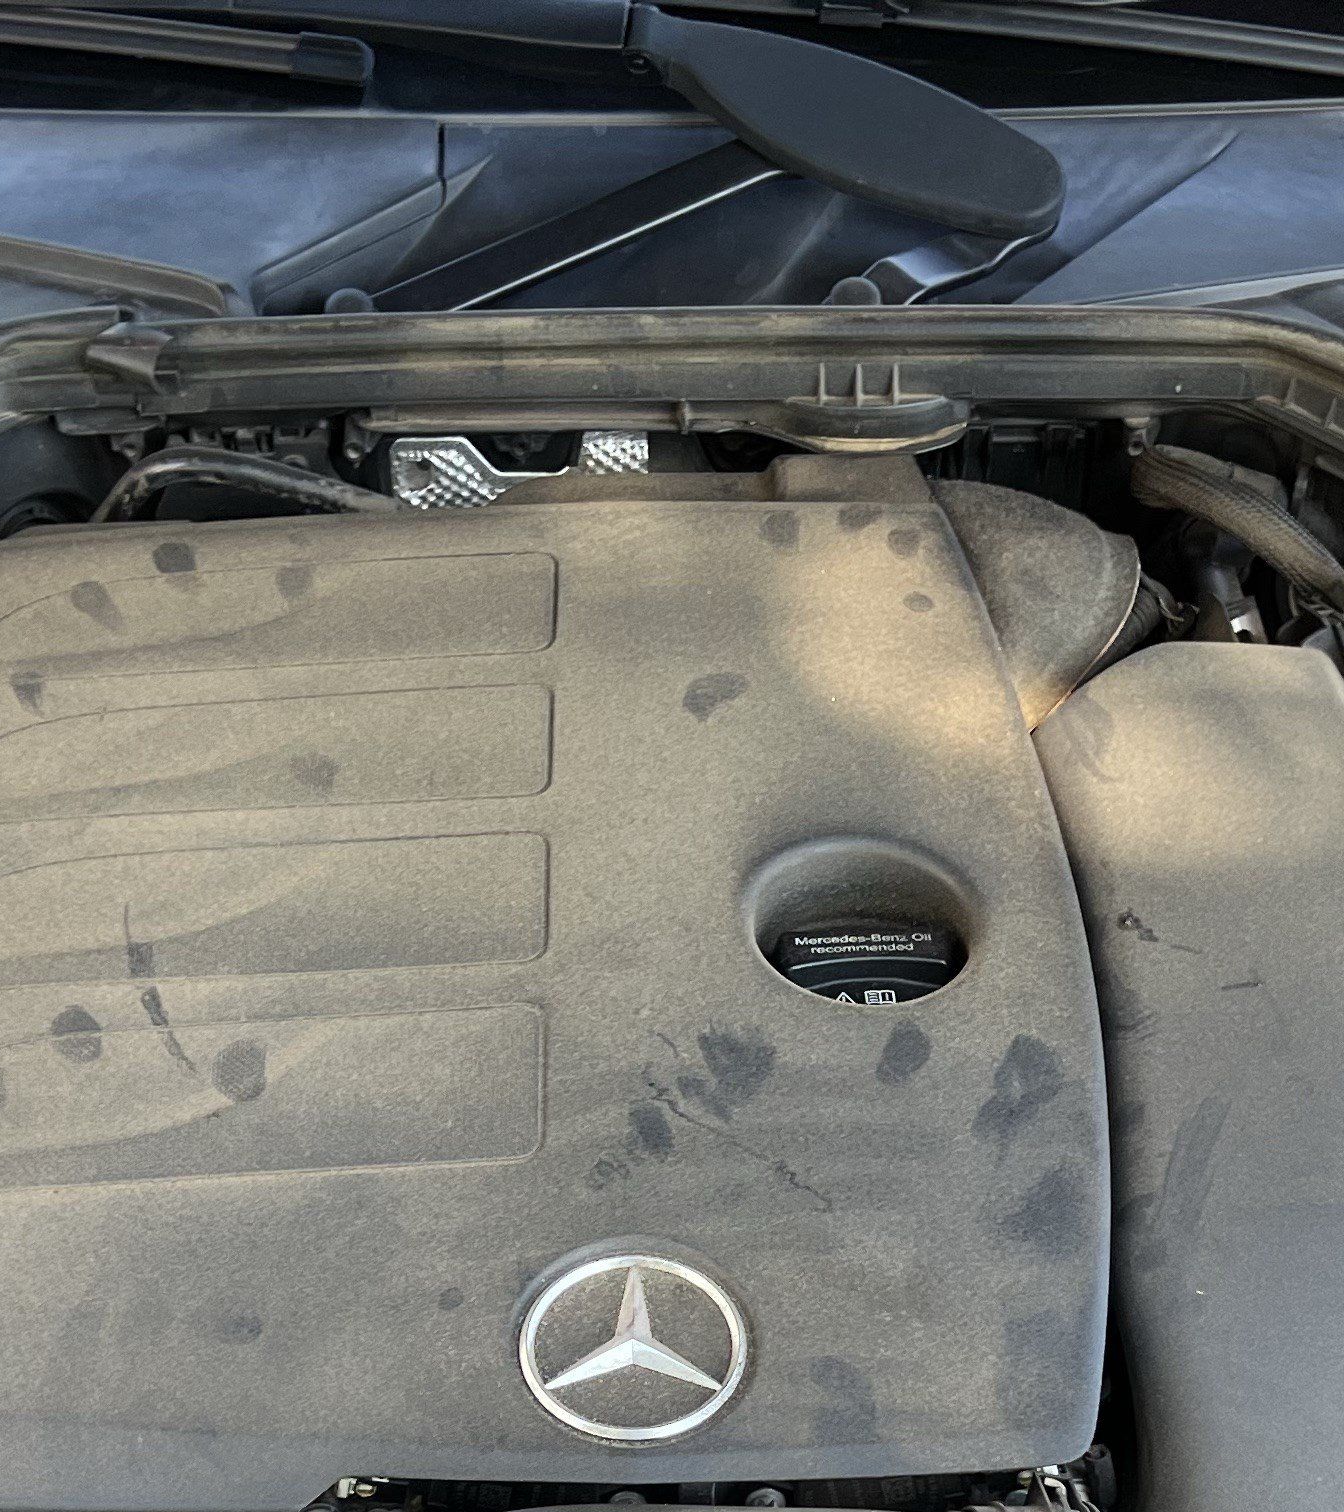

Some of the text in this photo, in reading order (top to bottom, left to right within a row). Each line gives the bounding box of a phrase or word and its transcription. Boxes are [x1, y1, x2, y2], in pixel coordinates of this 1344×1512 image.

[794, 932, 932, 947] Mercedes-Benz Oil
[810, 942, 915, 954] recommended
